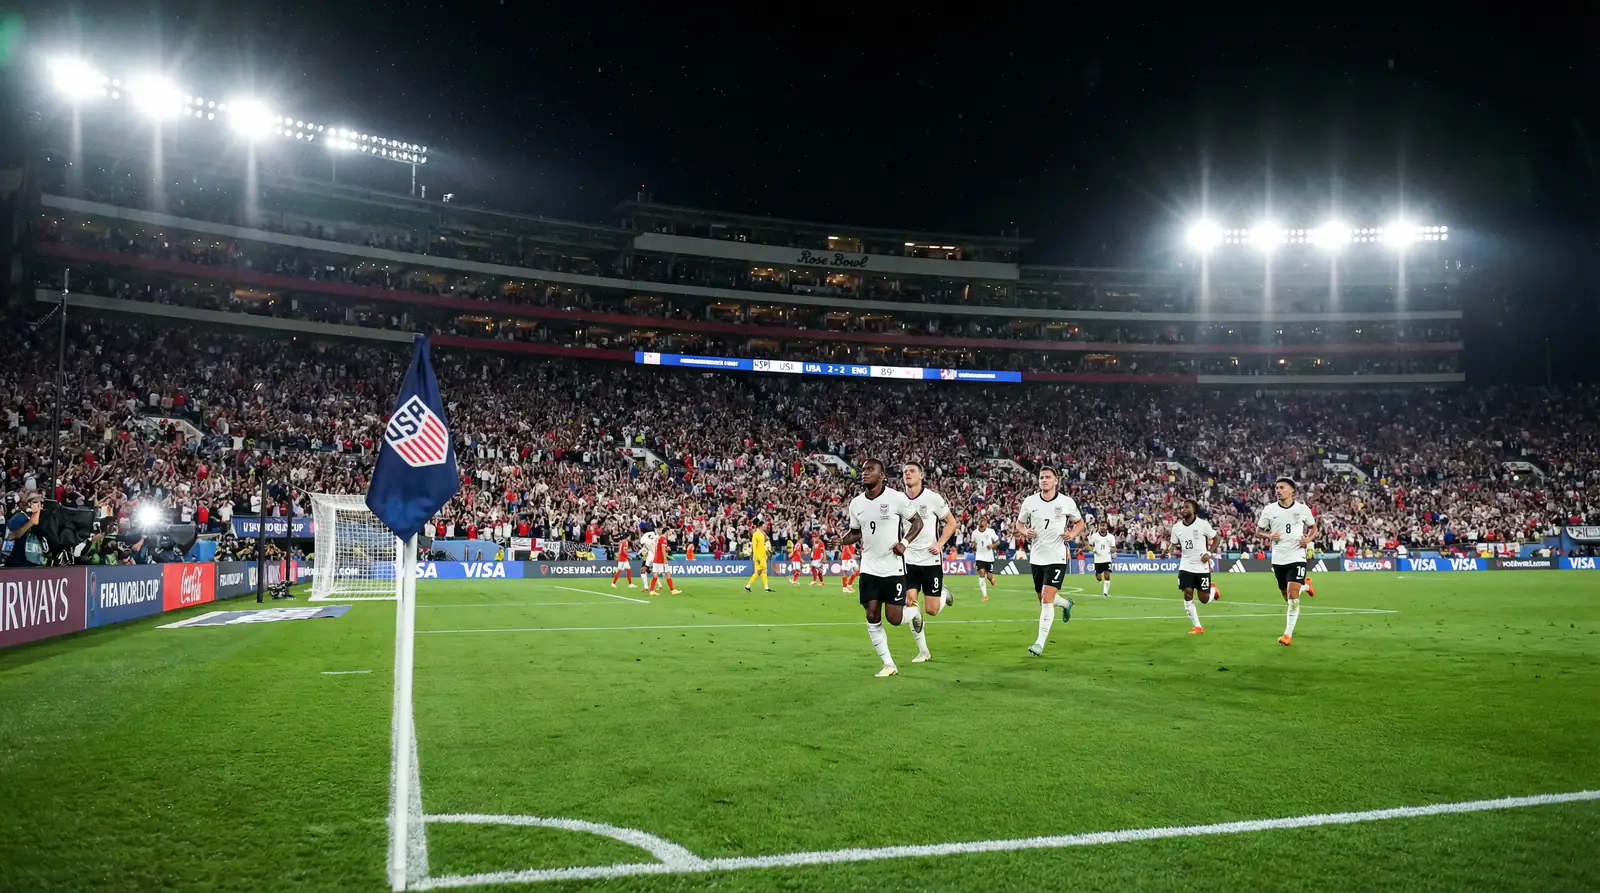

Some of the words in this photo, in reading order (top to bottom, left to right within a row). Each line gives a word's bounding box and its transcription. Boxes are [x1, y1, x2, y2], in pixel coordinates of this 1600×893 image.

[797, 250, 828, 265] Rose
[830, 253, 868, 268] Bowl
[805, 364, 821, 373] USA
[851, 367, 868, 375] ENG
[386, 400, 426, 442] USA
[869, 521, 876, 535] 9
[1044, 519, 1050, 530] 7
[1285, 523, 1291, 534] 8
[1184, 540, 1193, 550] 23
[942, 561, 966, 574] USA
[1128, 563, 1159, 571] WORLD
[1160, 562, 1178, 571] CUP
[1408, 558, 1437, 571] VISA
[1448, 558, 1477, 571] VISA
[1568, 557, 1596, 569] VISA
[416, 562, 438, 578] SA
[460, 562, 506, 578] VISA
[669, 565, 685, 574] IFA
[686, 565, 723, 574] WORLD
[728, 565, 745, 574] CUP
[1054, 569, 1061, 580] 7
[933, 577, 939, 589] 8
[100, 582, 119, 608] FIFA
[119, 580, 146, 606] WORLD
[146, 579, 159, 600] CUP
[896, 583, 903, 597] 9
